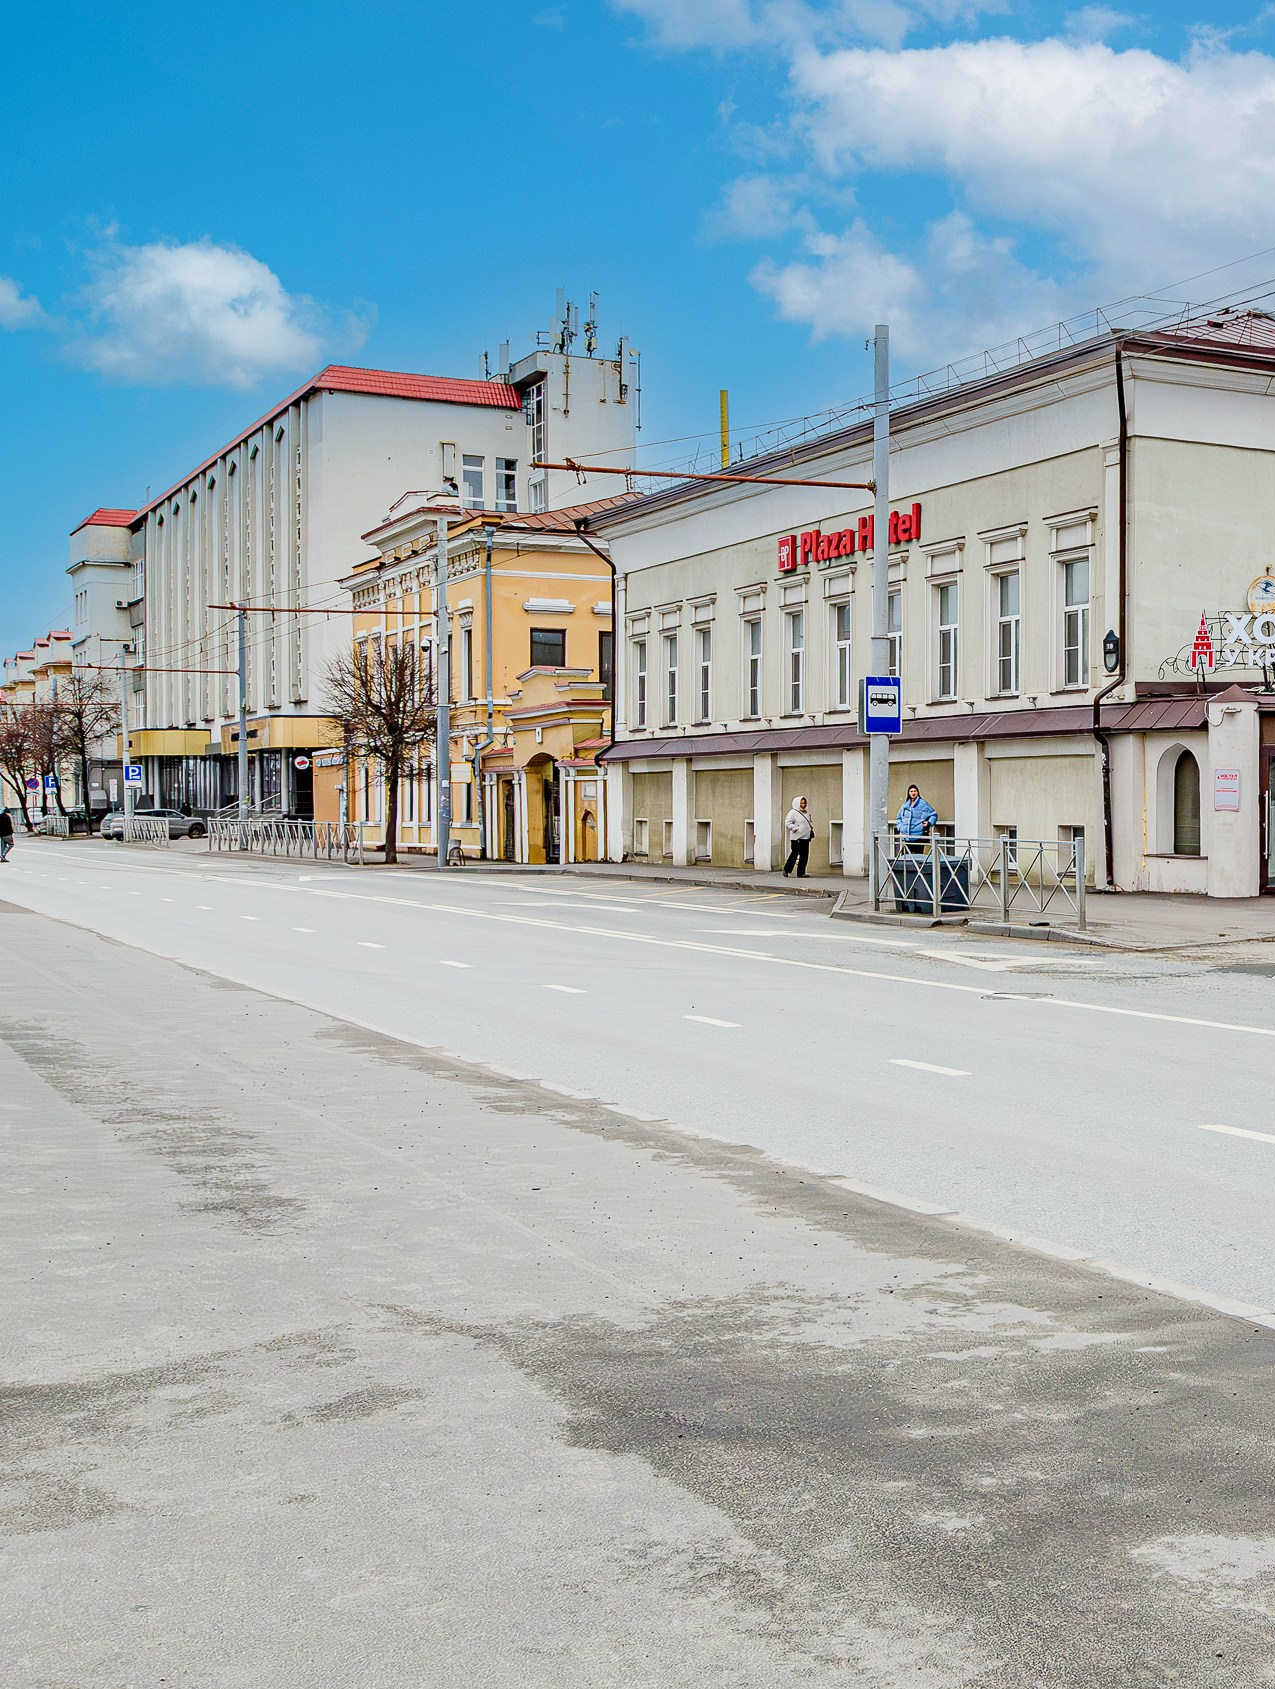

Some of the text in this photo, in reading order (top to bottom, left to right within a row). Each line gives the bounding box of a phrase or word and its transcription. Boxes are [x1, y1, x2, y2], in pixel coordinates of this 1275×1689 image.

[800, 502, 922, 566] Plaza Htel
[1224, 648, 1242, 666] У
[128, 766, 139, 779] P
